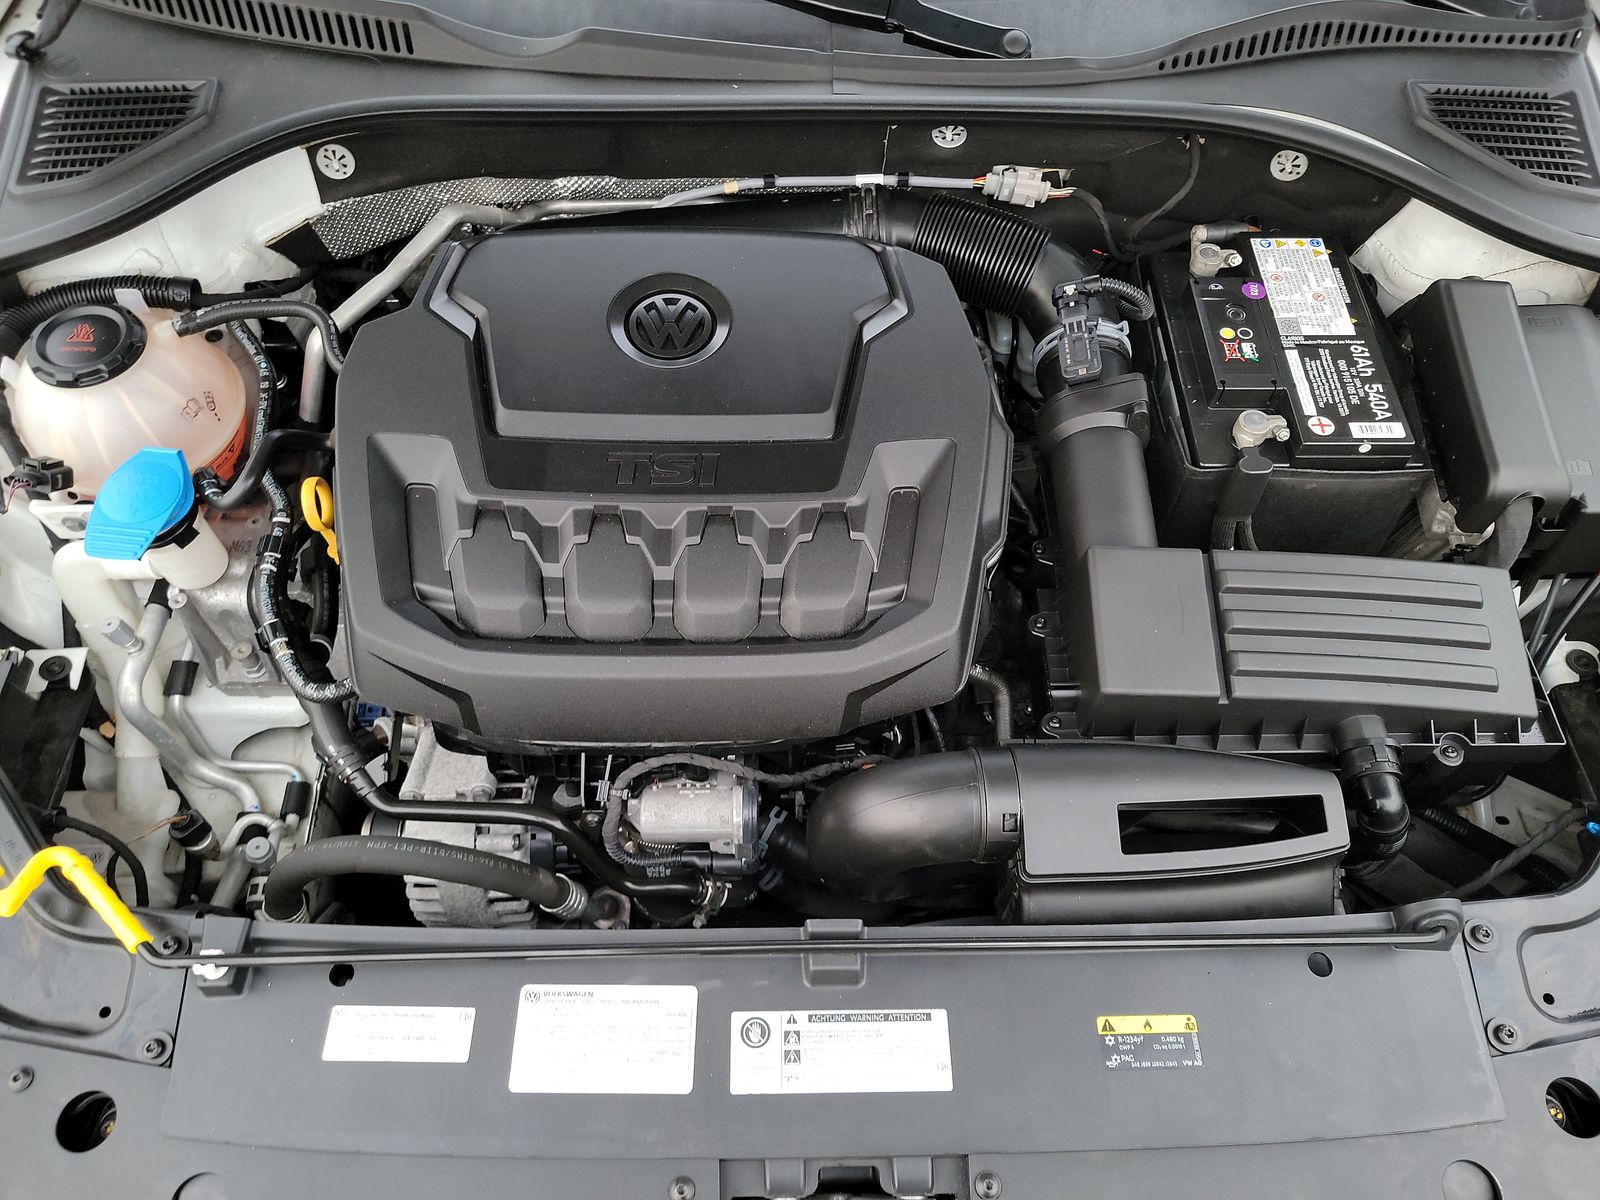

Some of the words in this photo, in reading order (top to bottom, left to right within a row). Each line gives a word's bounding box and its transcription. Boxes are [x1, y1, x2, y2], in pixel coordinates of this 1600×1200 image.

[1341, 371, 1353, 383] 915
[1350, 344, 1376, 377] 61Ah
[1364, 383, 1393, 421] 540A
[1345, 382, 1357, 395] 105
[1349, 395, 1361, 405] DE
[607, 452, 720, 487] TSI
[811, 1014, 846, 1022] ACHTUNG
[850, 1013, 885, 1022] WARNING
[888, 1013, 928, 1021] ATTENTION
[1118, 1035, 1144, 1045] R-1234yf
[1121, 1054, 1135, 1062] PAG
